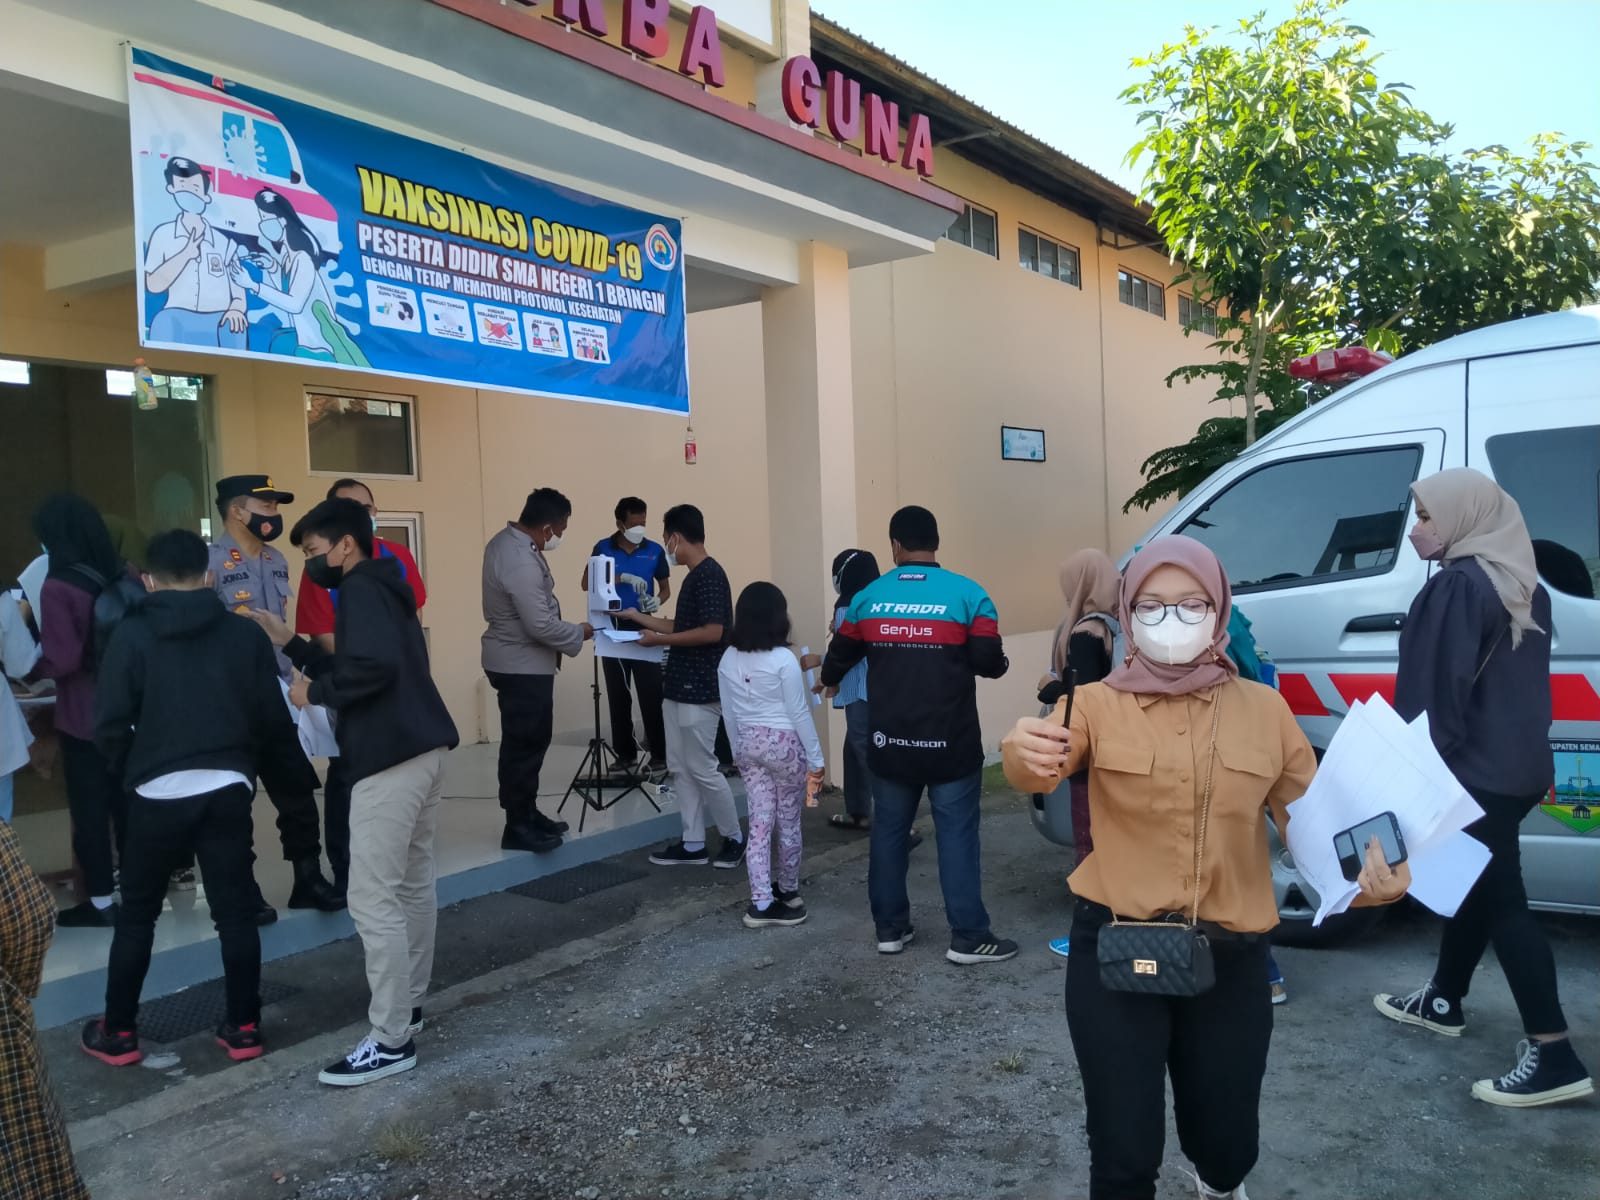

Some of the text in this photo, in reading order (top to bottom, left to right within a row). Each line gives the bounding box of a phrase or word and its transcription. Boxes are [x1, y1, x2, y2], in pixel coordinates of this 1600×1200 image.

[782, 54, 934, 177] GUNA
[356, 166, 644, 282] VAKSINASI COVID-19
[358, 222, 666, 315] PESERTA DIDIK SMA NEGERI 1 BRINGIN
[361, 254, 622, 324] DENGAN TETAP MEMATUHI PROTOKOL KESEHATAN
[870, 602, 947, 615] XTRADA
[880, 624, 933, 638] Genjus
[888, 737, 947, 748] POLYGON
[1550, 743, 1579, 751] UPATEN
